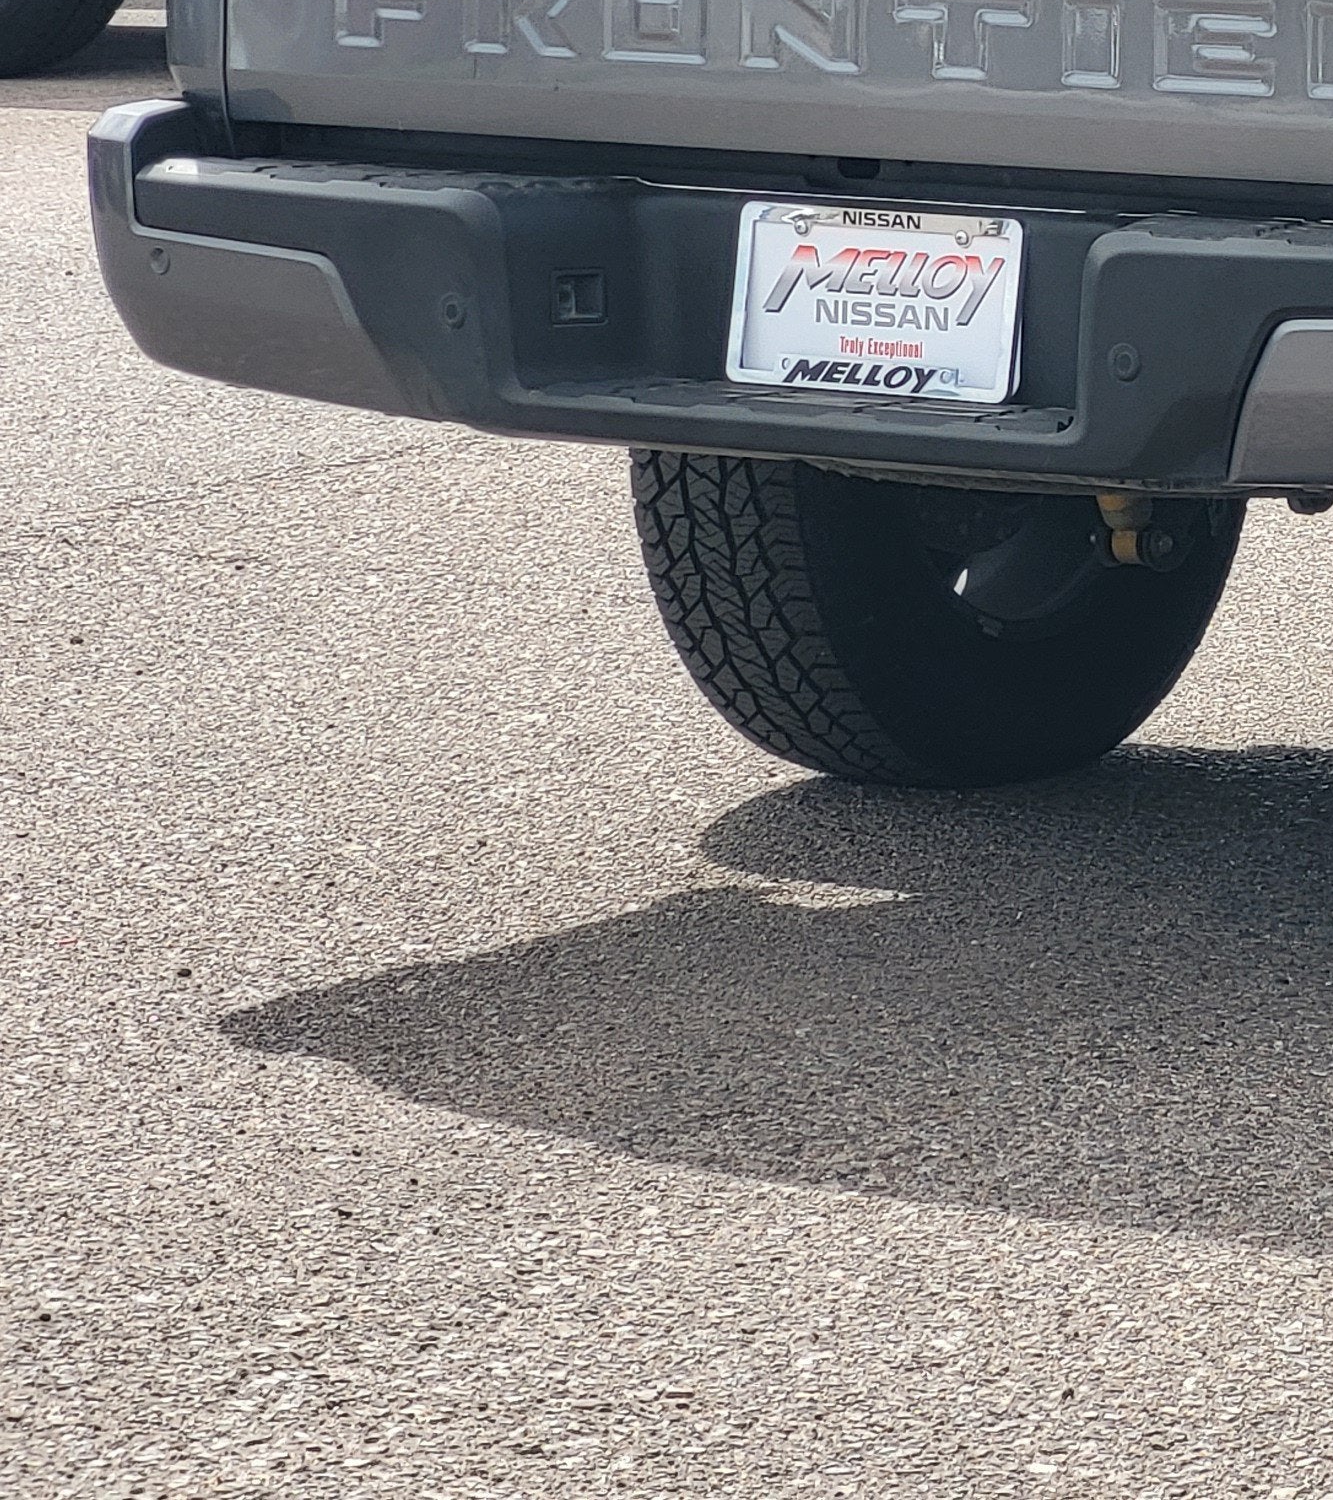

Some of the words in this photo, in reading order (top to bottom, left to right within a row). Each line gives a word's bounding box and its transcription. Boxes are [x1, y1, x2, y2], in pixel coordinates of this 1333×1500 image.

[842, 211, 921, 230] NISSAN
[815, 299, 949, 331] NISSAN
[840, 336, 864, 357] Truly
[867, 338, 923, 359] Exceptional
[782, 358, 938, 393] MELLOY
